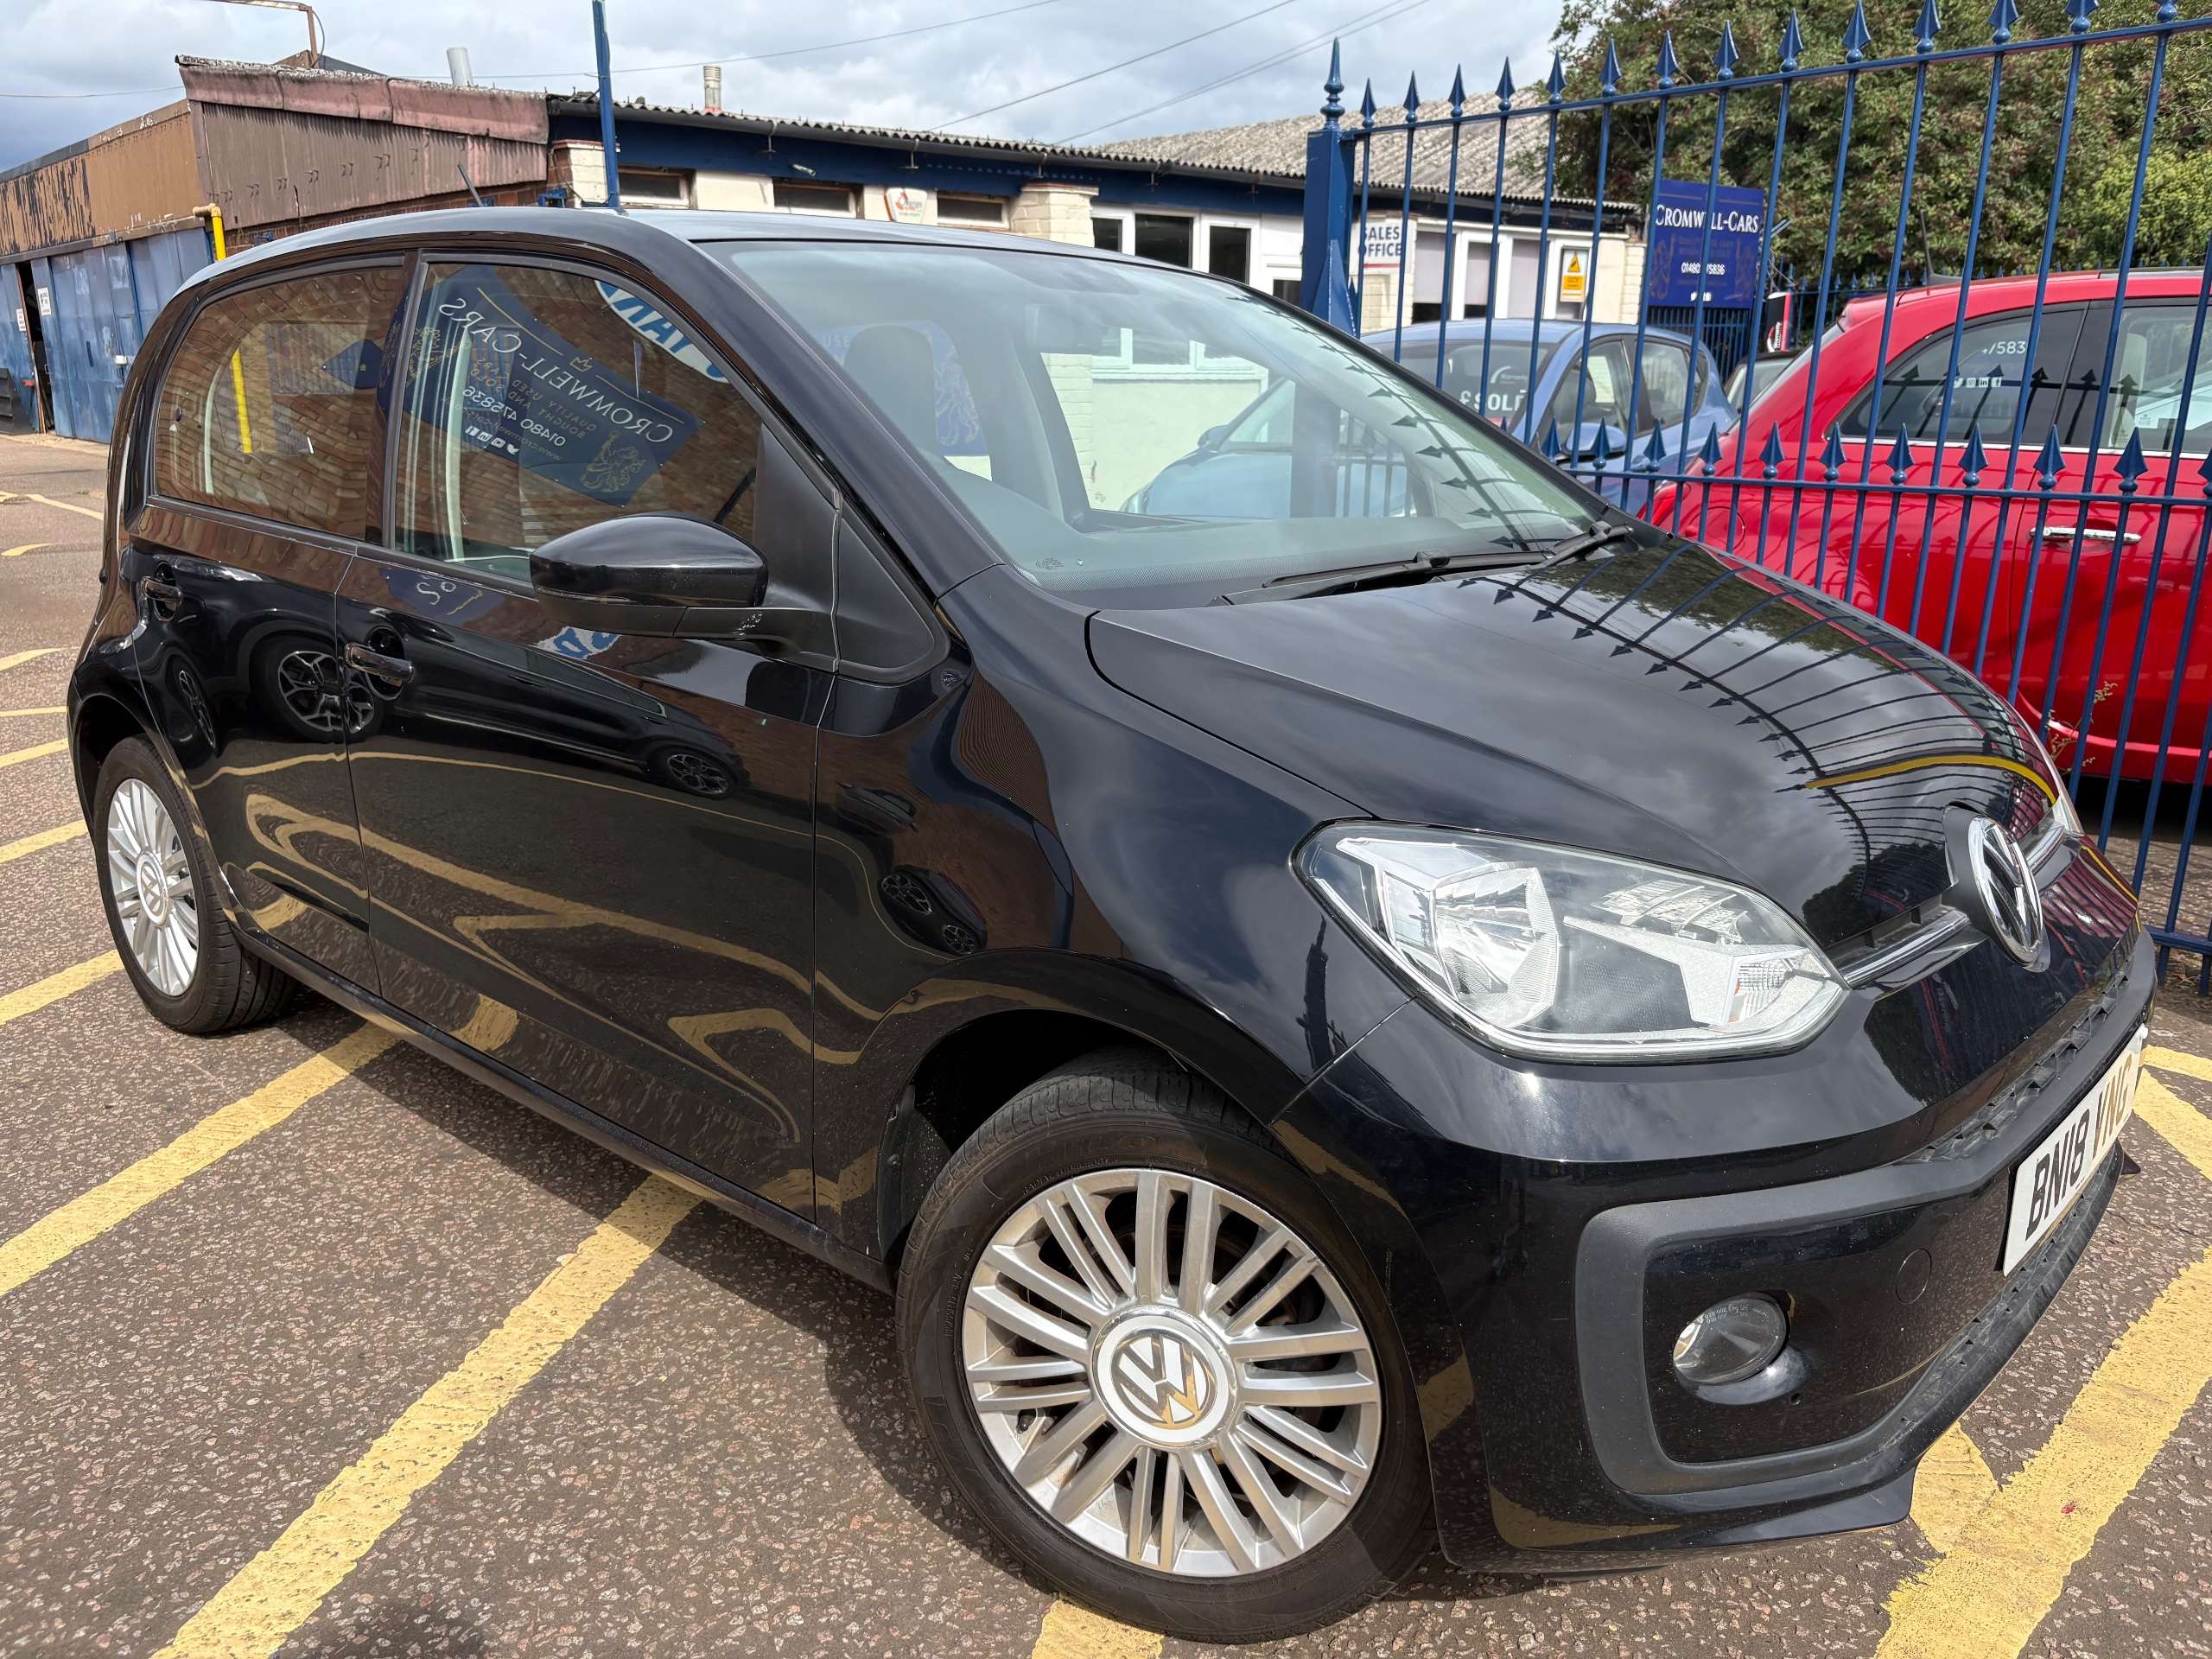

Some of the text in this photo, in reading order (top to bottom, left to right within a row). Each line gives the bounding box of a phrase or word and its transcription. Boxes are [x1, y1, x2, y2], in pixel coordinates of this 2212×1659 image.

[1656, 204, 1759, 233] CROMWLL-CARS
[1361, 226, 1400, 241] ALES
[1358, 243, 1403, 257] FFICE
[2025, 1108, 2090, 1242] BN18
